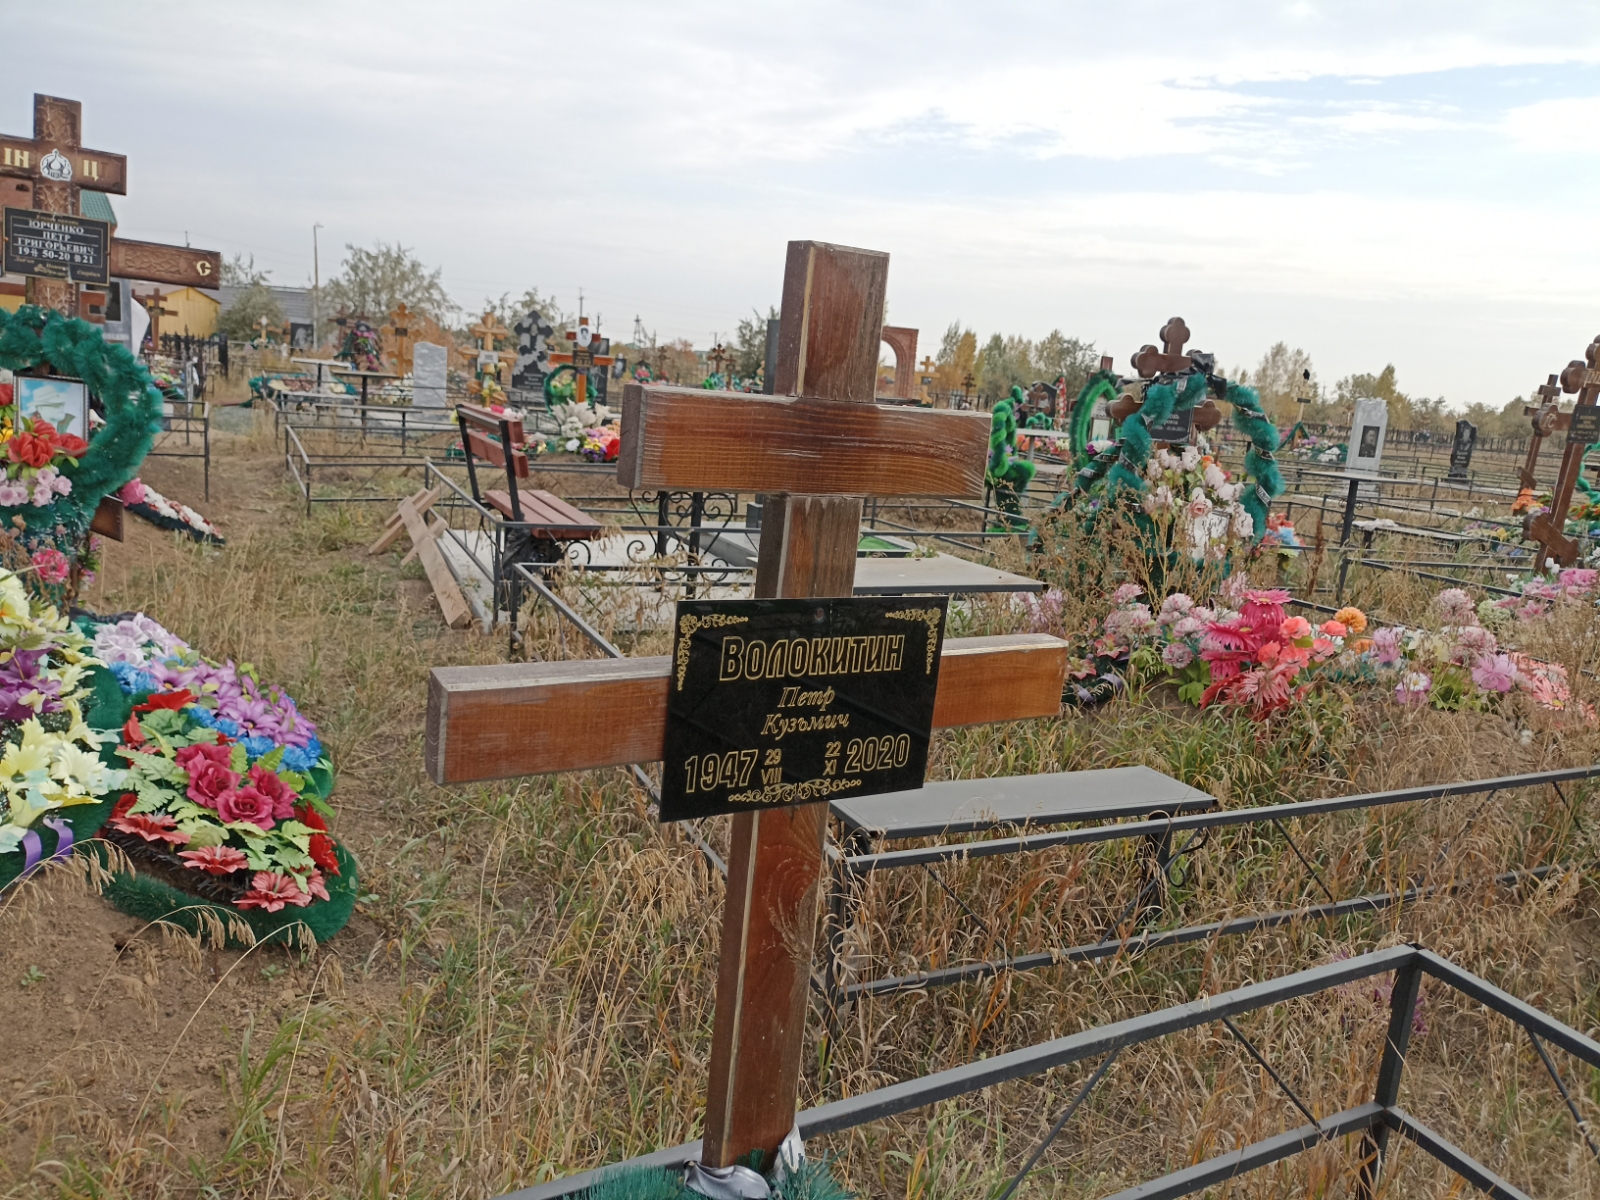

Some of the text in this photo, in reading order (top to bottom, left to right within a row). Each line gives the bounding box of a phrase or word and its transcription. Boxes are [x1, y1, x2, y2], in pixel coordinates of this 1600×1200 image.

[28, 219, 84, 235] ЮРЧЕНКО
[42, 231, 71, 242] ПЕТР
[17, 237, 95, 254] ГРИГОРЬЕВИЧ
[719, 634, 905, 682] ВОЛОКИТИН
[777, 685, 835, 711] Петр
[764, 748, 782, 765] 29
[824, 740, 841, 757] 22
[844, 733, 910, 773] 2020
[685, 749, 758, 793] 1947
[761, 767, 782, 784] VIII
